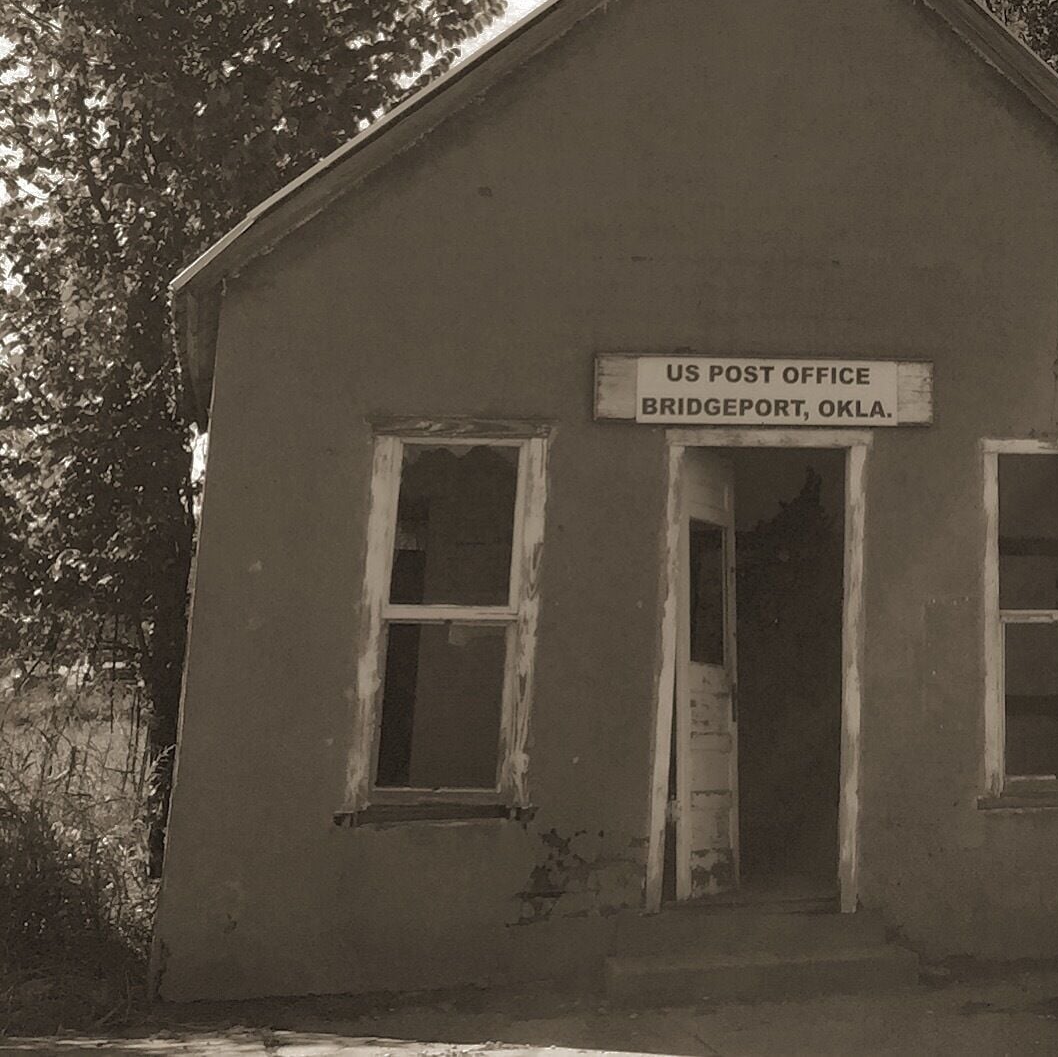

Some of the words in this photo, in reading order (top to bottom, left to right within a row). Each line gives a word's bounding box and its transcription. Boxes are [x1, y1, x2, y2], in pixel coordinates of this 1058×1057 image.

[667, 364, 700, 383] US
[709, 364, 775, 384] POST
[782, 365, 870, 385] OFFICE
[642, 397, 812, 422] BRIDGEPORT,
[818, 400, 893, 418] OKLA.
